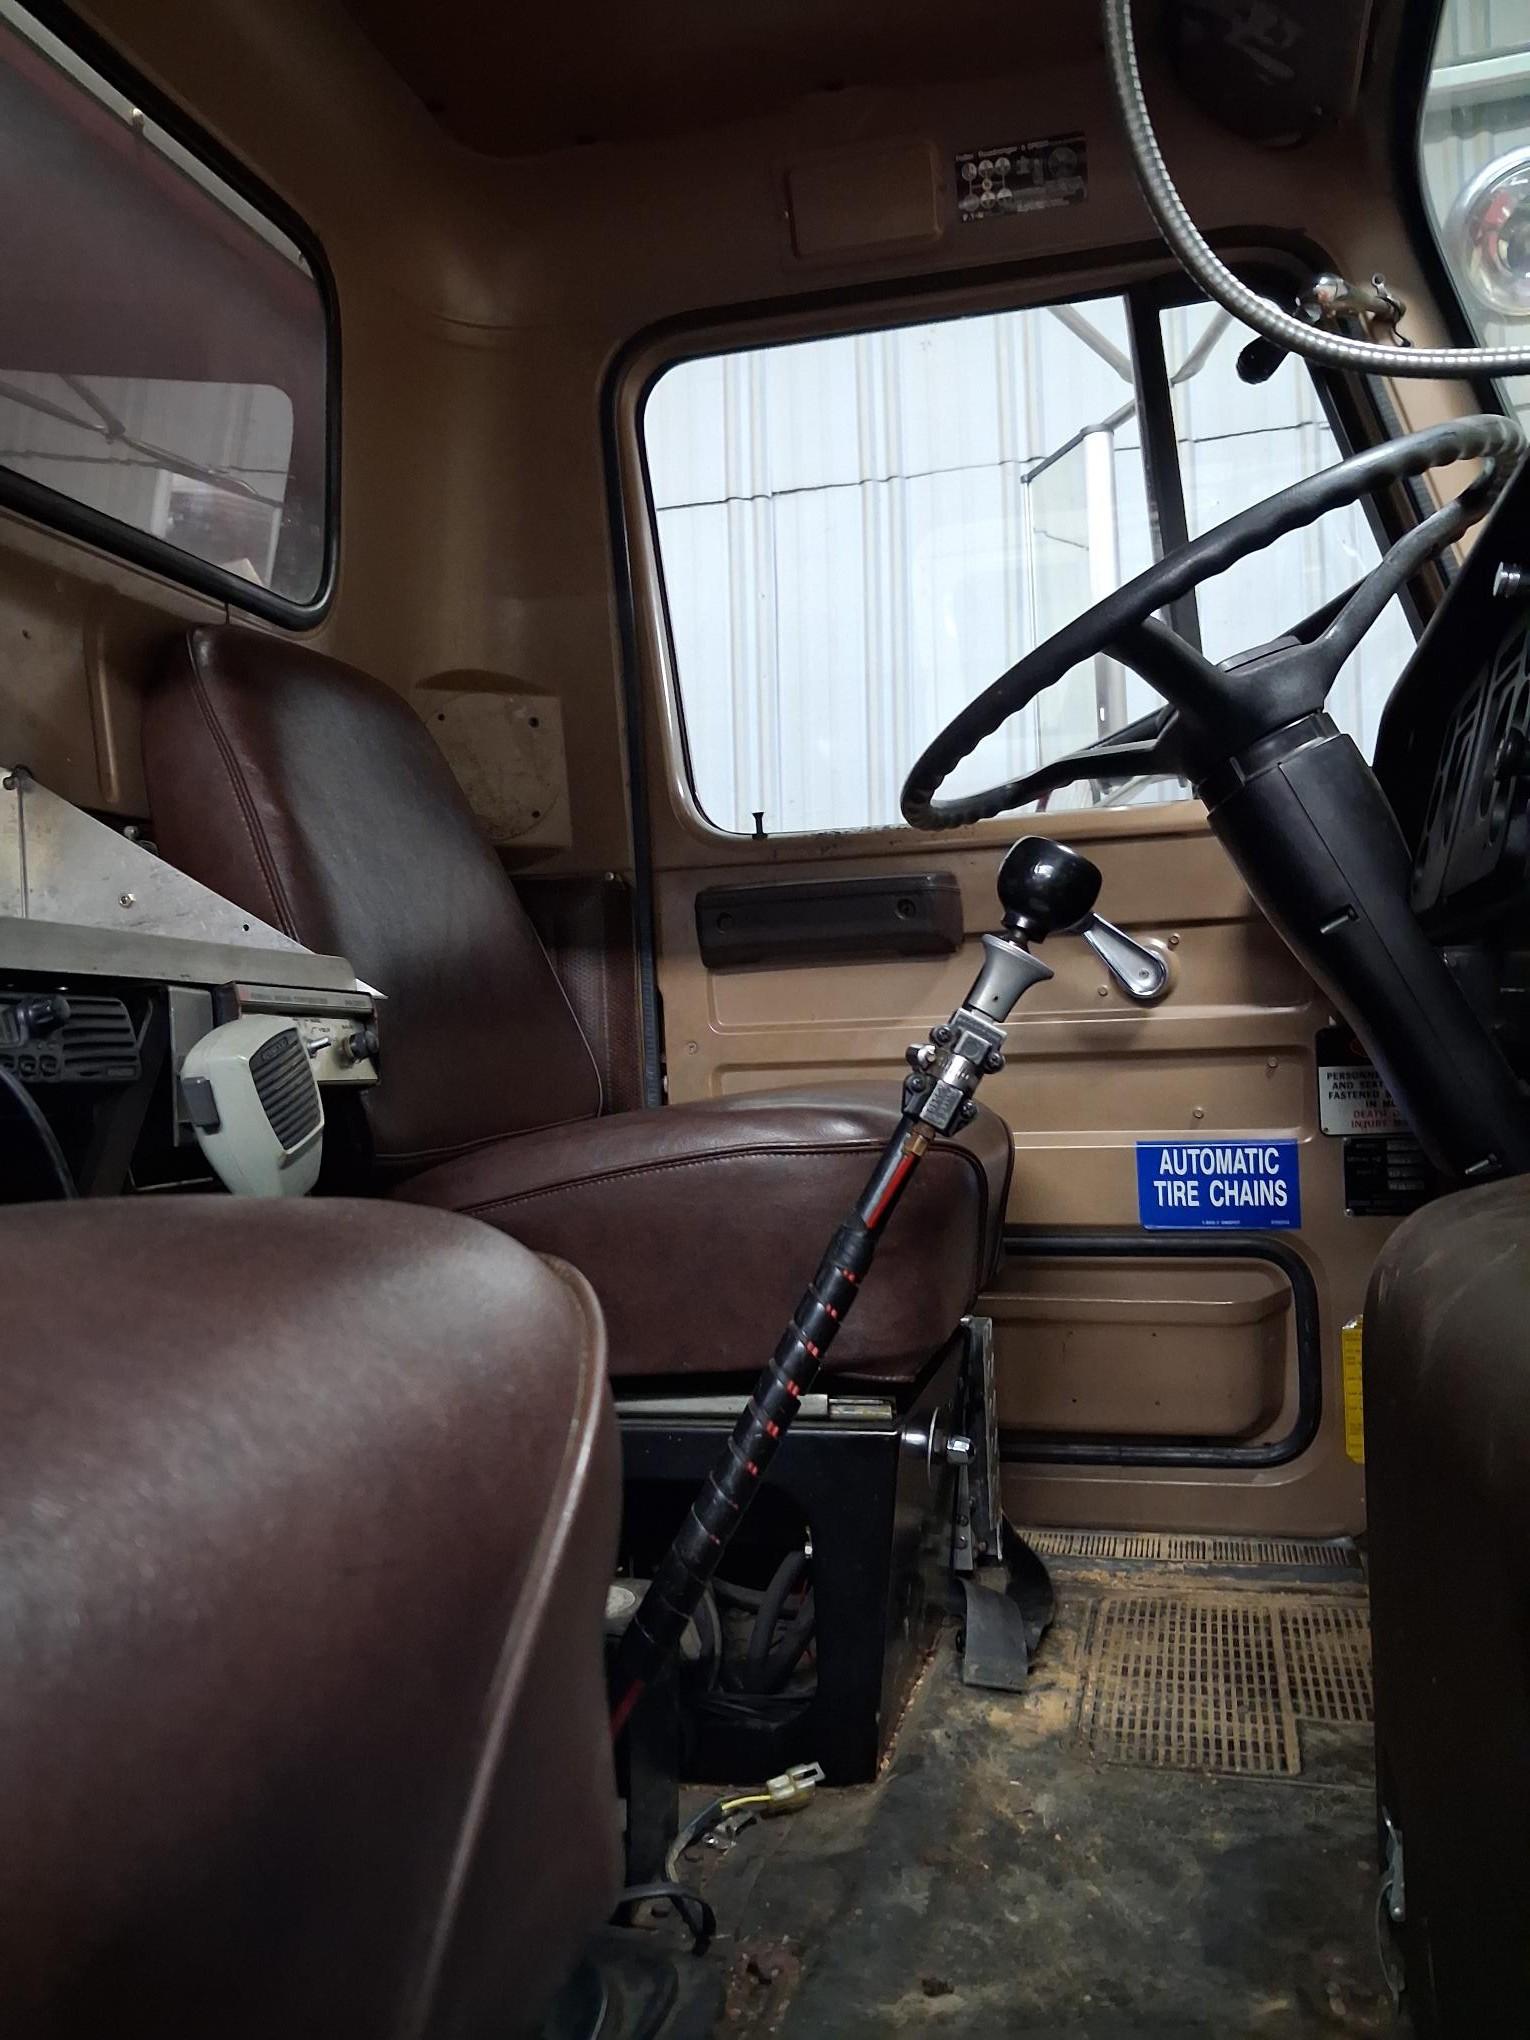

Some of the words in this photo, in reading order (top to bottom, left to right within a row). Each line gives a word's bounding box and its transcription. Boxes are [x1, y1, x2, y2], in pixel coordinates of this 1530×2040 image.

[1332, 1081, 1354, 1090] AND
[1328, 1090, 1380, 1100] FASTENED
[1365, 1100, 1377, 1108] IN
[1353, 1110, 1387, 1119] DEATH
[1351, 1119, 1388, 1129] INJURY
[1159, 1148, 1280, 1175] AUTOMATIC
[1153, 1180, 1200, 1207] TIRE
[1209, 1179, 1288, 1207] CHAINS
